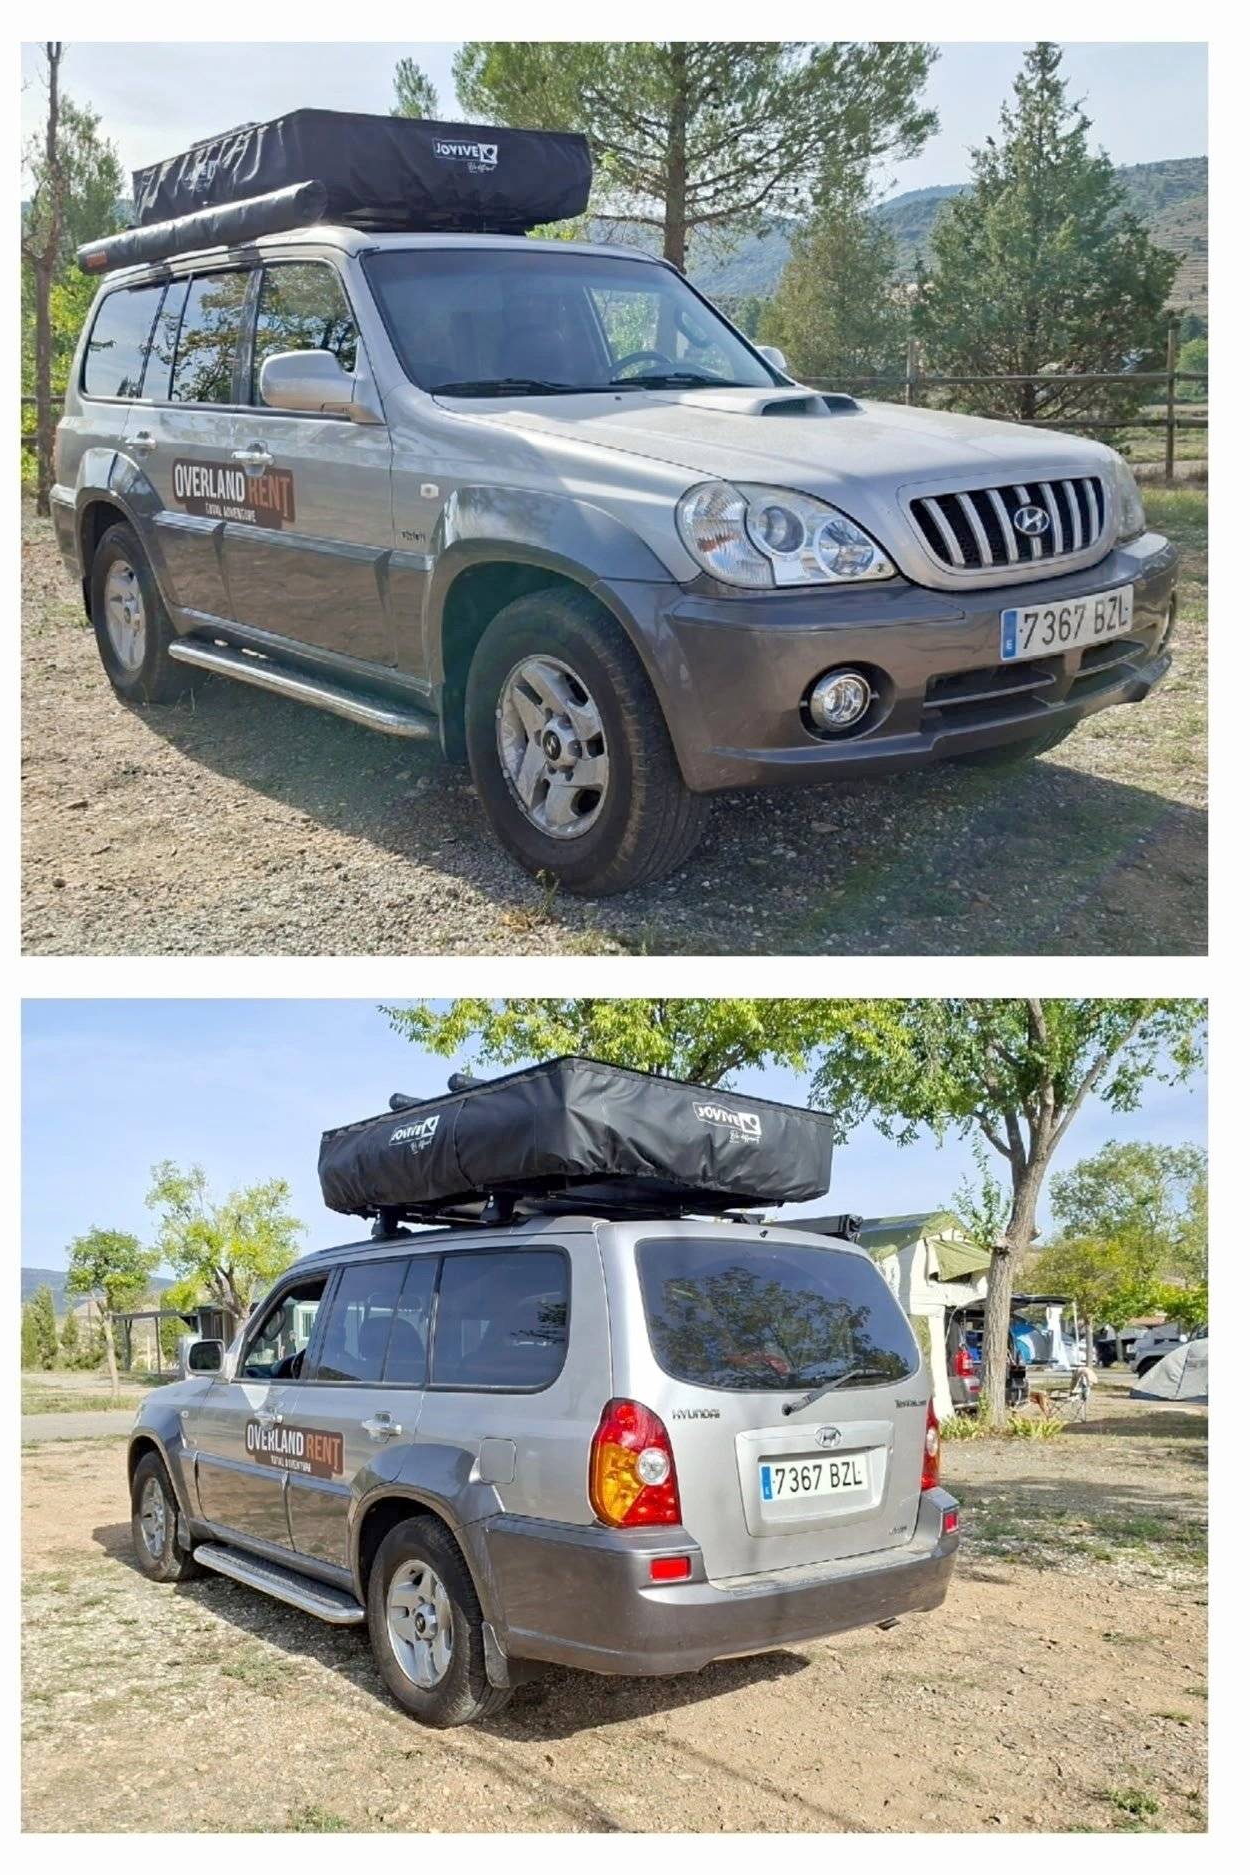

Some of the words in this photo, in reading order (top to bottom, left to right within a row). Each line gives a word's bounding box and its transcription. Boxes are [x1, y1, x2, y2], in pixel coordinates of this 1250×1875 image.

[436, 142, 479, 157] JOVIVE
[174, 463, 246, 503] OVERLAND
[248, 475, 291, 518] RENT
[1023, 603, 1087, 650] 7367
[1094, 593, 1128, 635] BZL
[246, 1424, 304, 1456] OVERLAND
[306, 1434, 341, 1470] RENT
[775, 1464, 822, 1495] 7367
[830, 1461, 862, 1488] BZL
